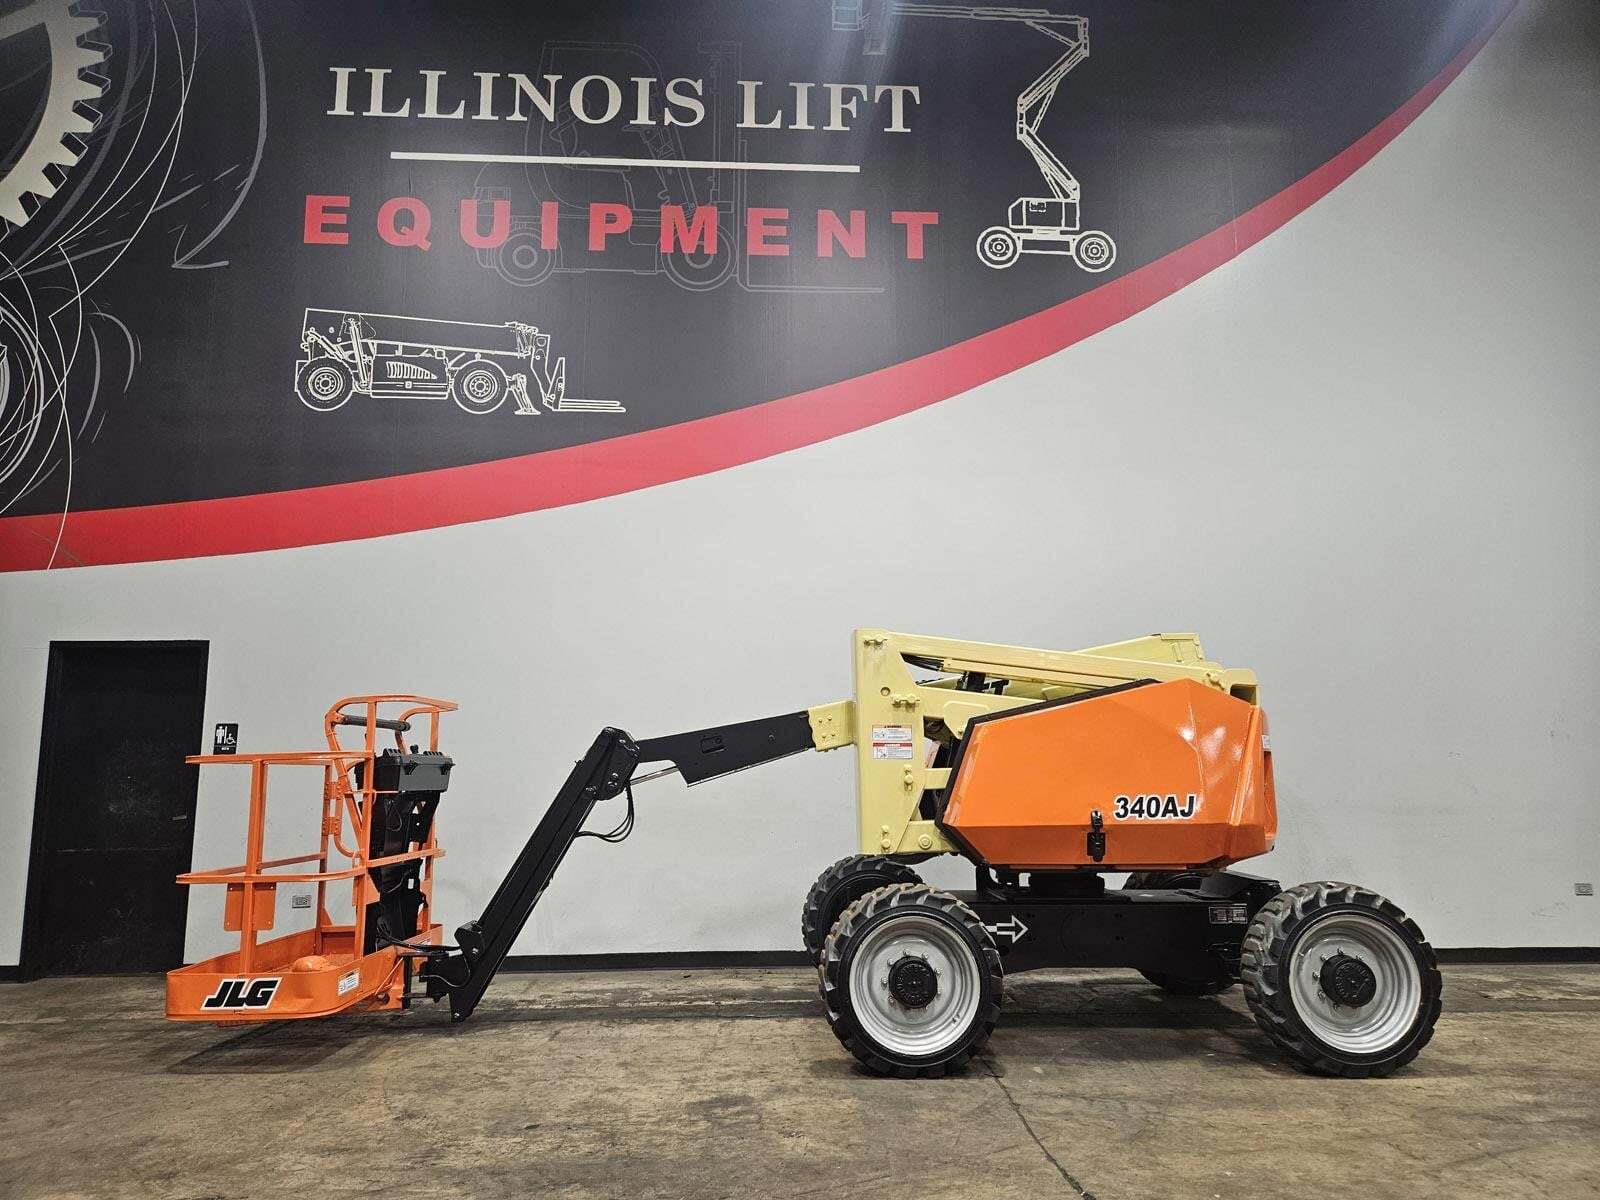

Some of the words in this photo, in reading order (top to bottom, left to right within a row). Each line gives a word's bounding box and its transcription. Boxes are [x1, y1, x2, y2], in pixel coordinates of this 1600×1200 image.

[327, 66, 705, 128] ILLINOIS
[735, 80, 921, 133] LIFT
[303, 194, 939, 261] EQUIPMENT
[1114, 795, 1196, 820] 340AJ
[203, 980, 280, 1009] JLG
